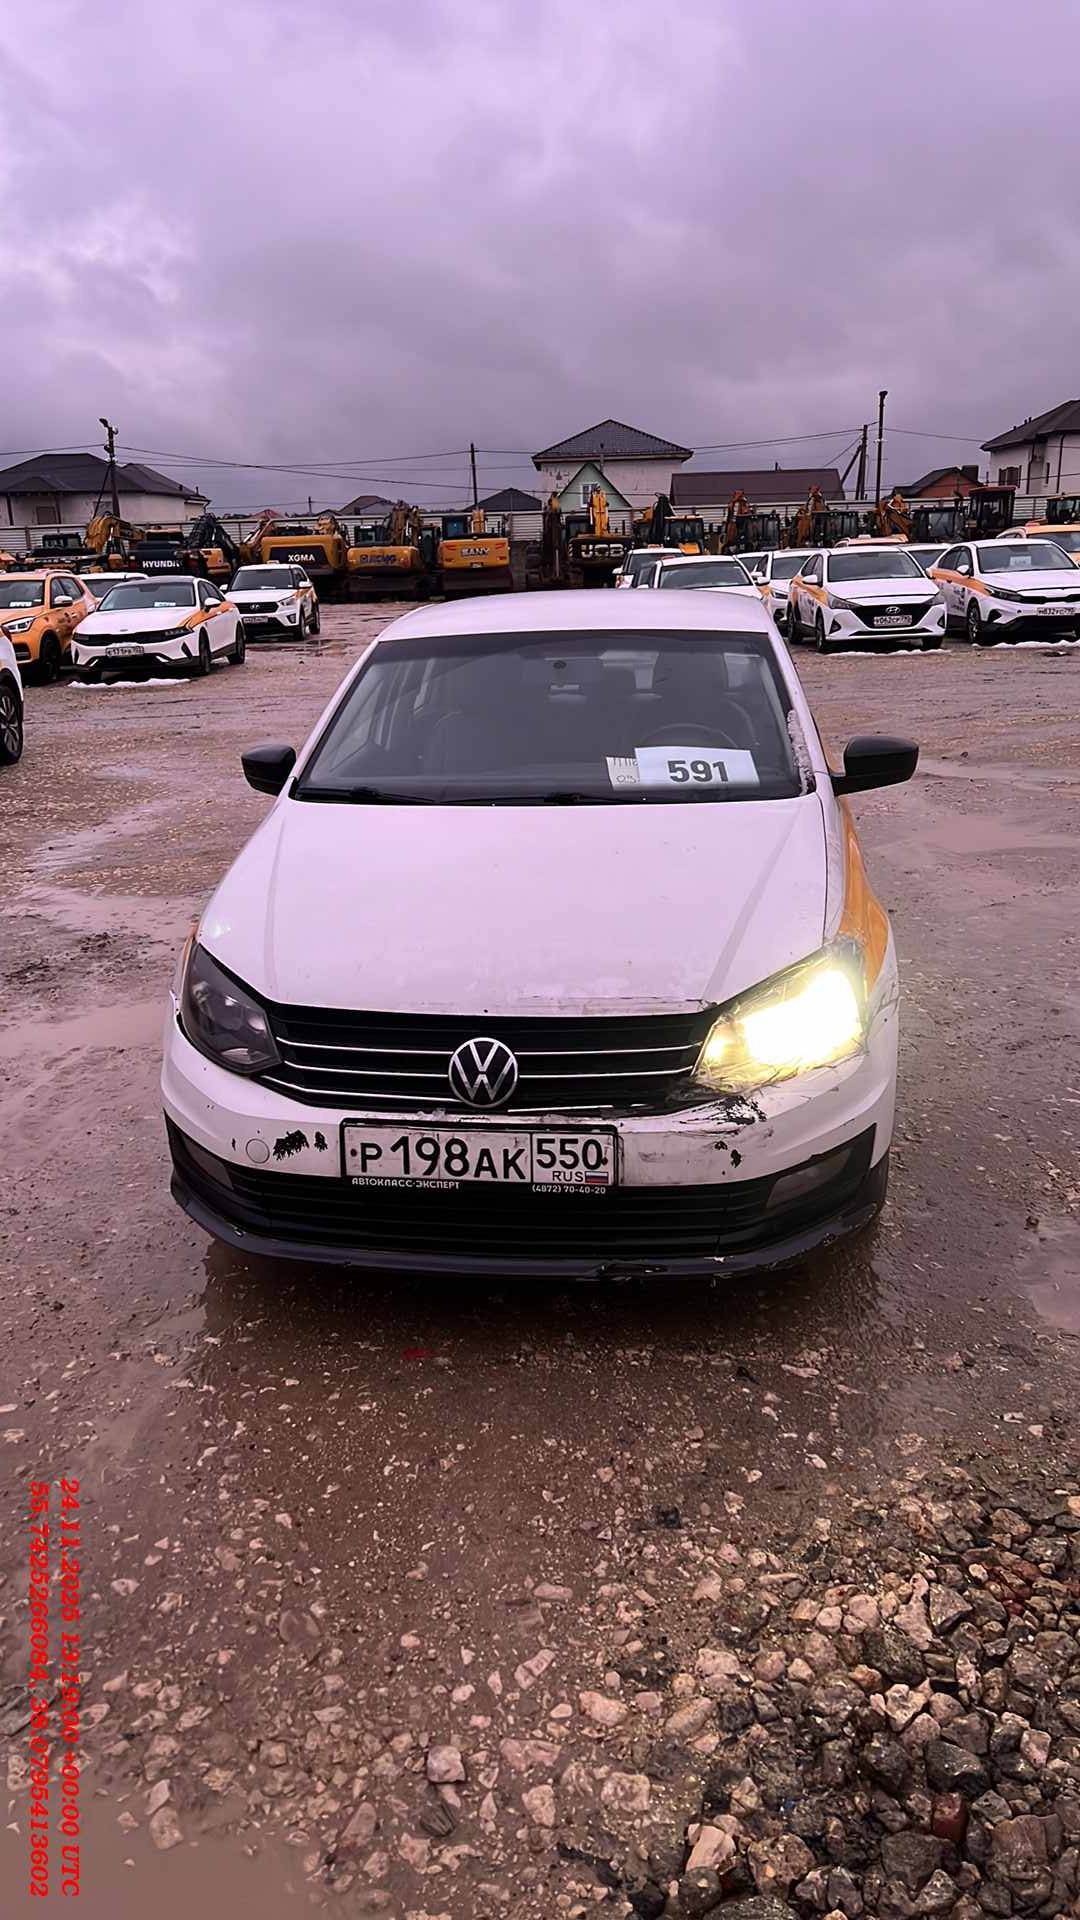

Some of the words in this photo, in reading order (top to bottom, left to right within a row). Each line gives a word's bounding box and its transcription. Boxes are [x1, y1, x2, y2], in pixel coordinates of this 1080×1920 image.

[288, 554, 316, 562] XGMA
[668, 760, 728, 782] 591
[360, 1135, 526, 1180] Р198АК
[536, 1138, 603, 1170] 550
[552, 1171, 584, 1183] RUS
[352, 1177, 460, 1190] АВТОКЛАСС-ЭКСПЕРТ
[532, 1184, 561, 1193] (4872)
[563, 1185, 606, 1194] 70-40-20
